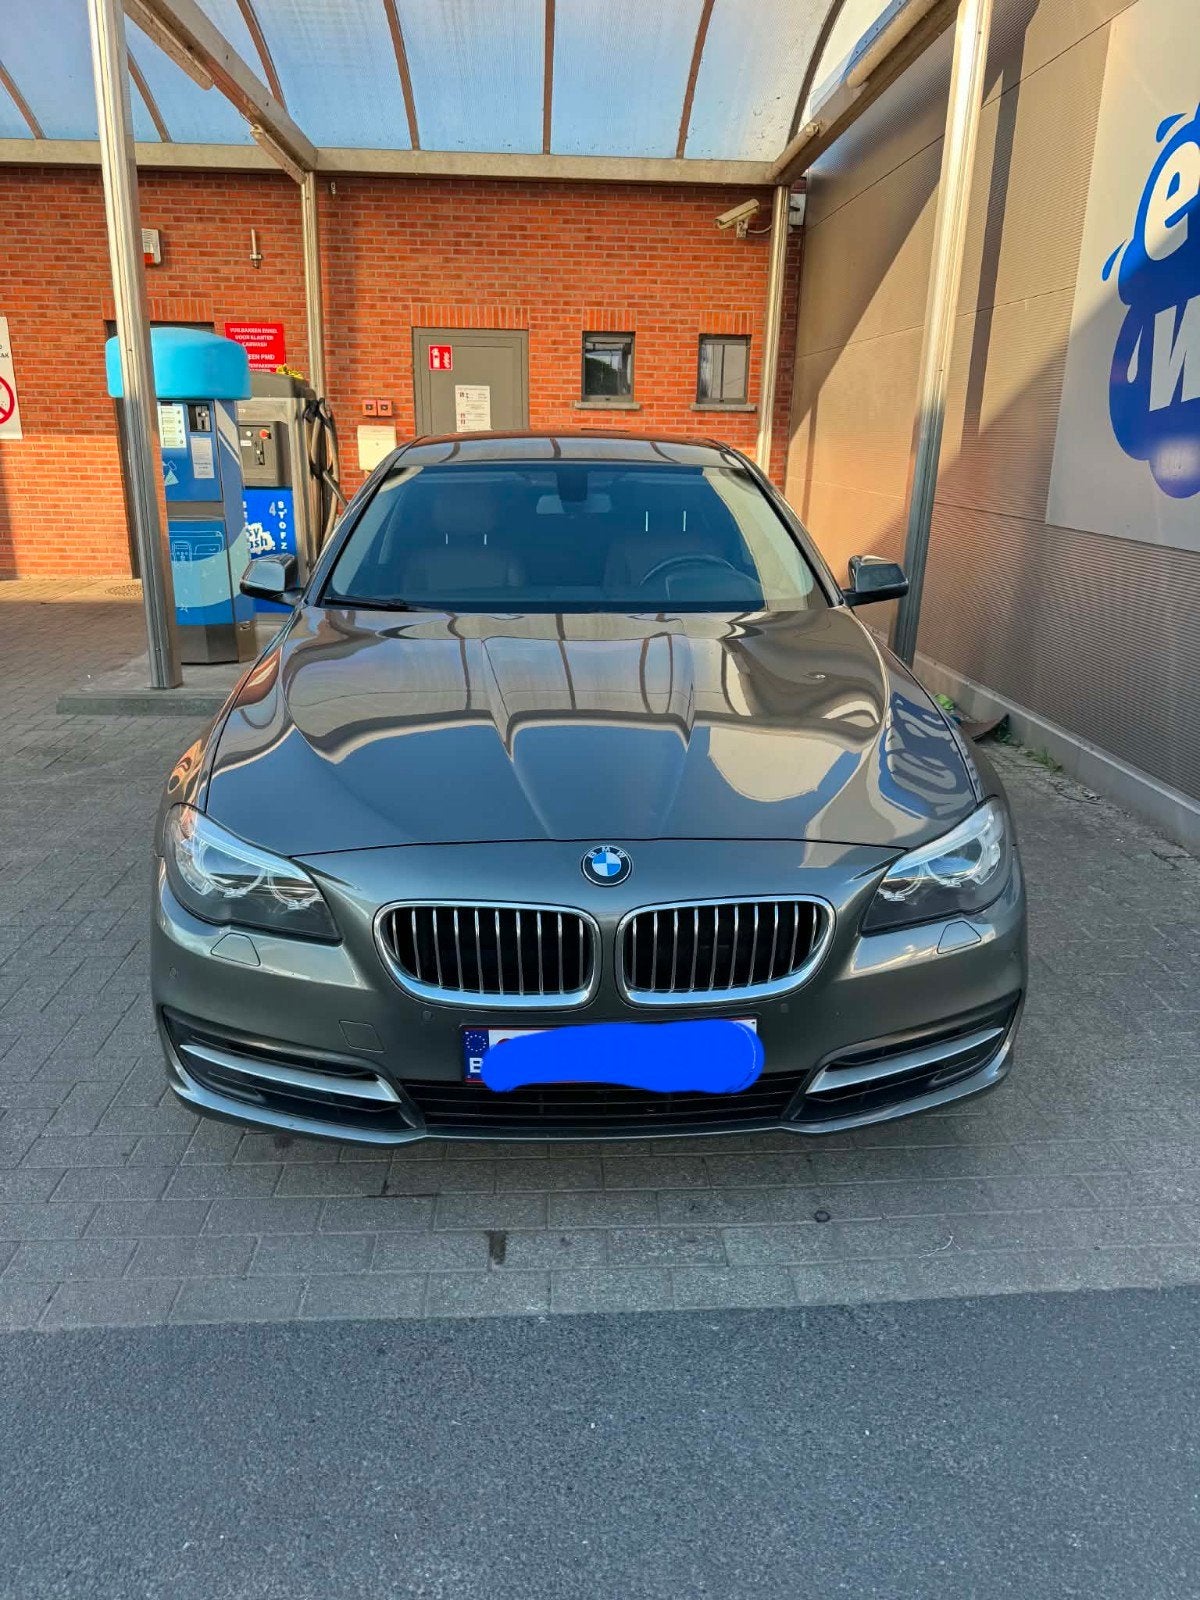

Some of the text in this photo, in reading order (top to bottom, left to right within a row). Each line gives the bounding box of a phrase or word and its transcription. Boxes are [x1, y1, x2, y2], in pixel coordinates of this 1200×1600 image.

[260, 353, 276, 361] PMD
[269, 501, 276, 516] 4
[587, 845, 628, 859] BMW
